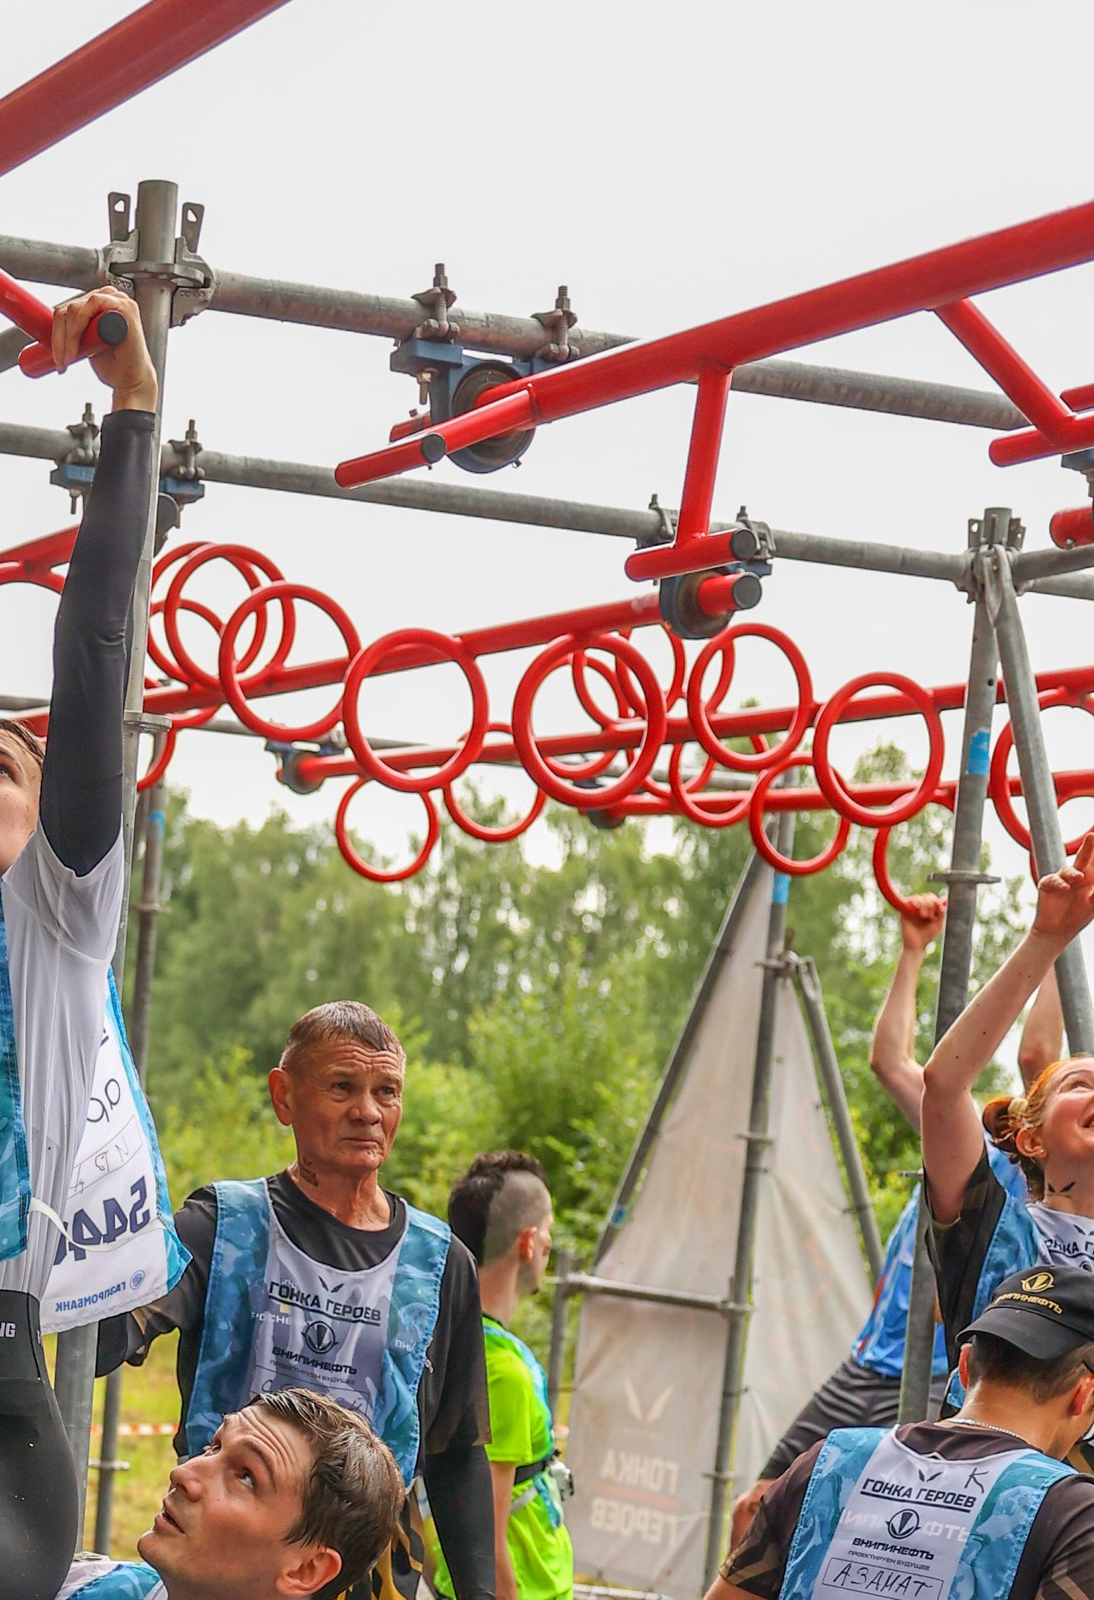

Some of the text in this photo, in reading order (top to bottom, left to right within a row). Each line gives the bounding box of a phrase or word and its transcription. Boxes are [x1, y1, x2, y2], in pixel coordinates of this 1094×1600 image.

[269, 1281, 381, 1321] ГОНКА ГЕРОЕВ
[272, 1346, 357, 1374] ВНИПИНЕФТЬ
[862, 1478, 977, 1508] ГОНКА ГЕРОЕВ
[852, 1537, 934, 1560] ВНИПИНЕФТЬ
[833, 1562, 933, 1597] АЗАМАТ
